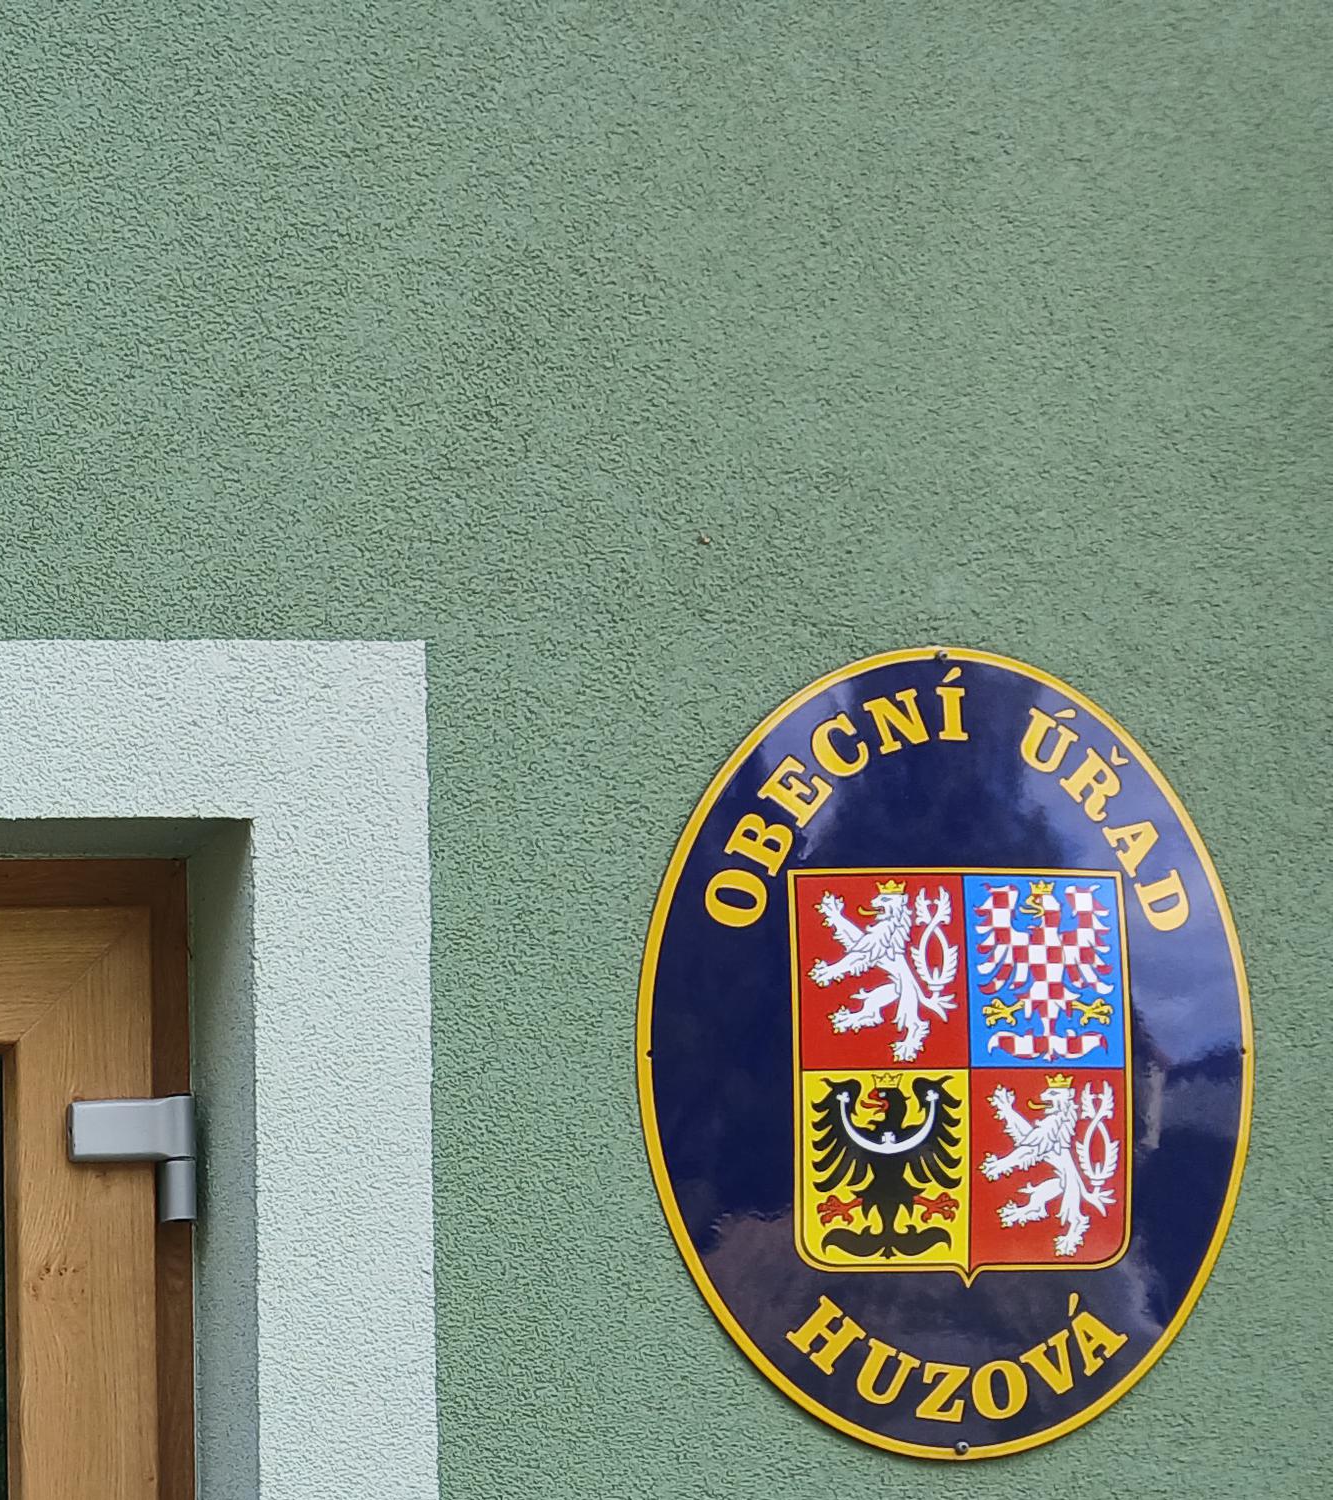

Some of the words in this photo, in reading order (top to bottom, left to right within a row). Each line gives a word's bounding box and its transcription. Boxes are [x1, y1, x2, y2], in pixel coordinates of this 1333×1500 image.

[703, 667, 969, 930] OBECNÍ
[1018, 706, 1191, 932] ÚŘAD
[785, 1293, 1129, 1424] HUZOVÁ
